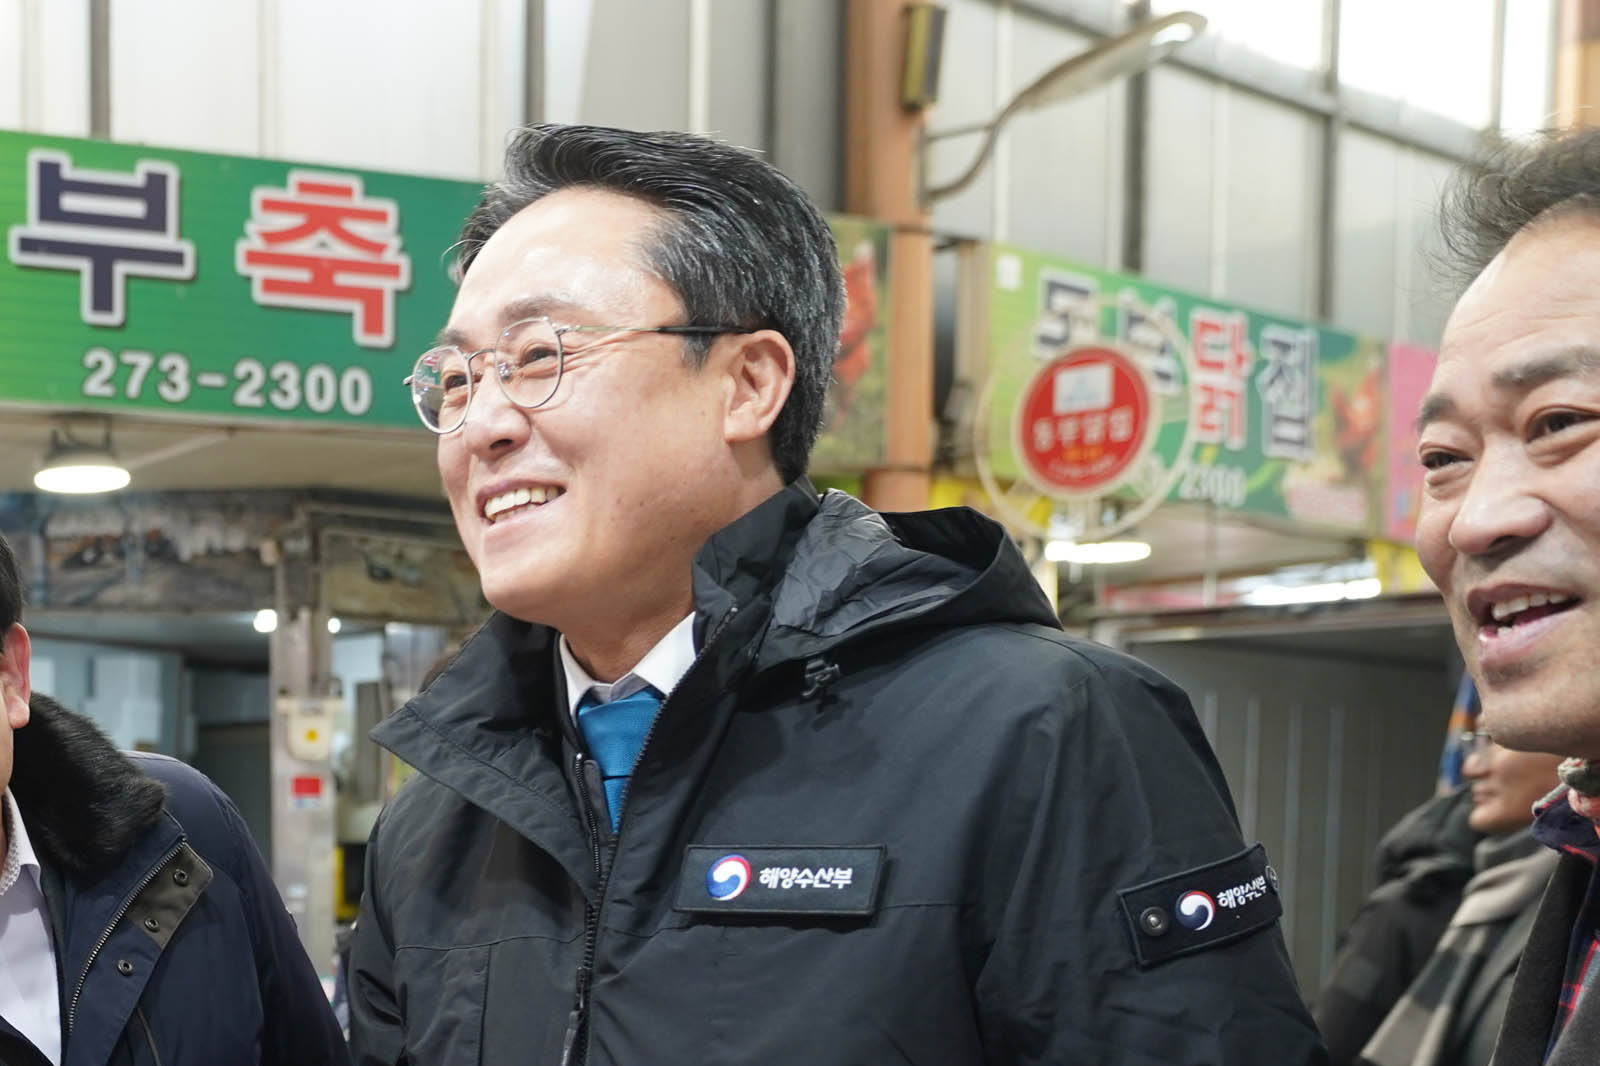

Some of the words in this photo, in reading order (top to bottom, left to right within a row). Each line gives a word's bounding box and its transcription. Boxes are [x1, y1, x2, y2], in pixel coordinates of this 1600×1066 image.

[82, 346, 373, 417] 273-2300
[758, 866, 853, 890] 해양수산부
[1215, 874, 1268, 910] 해양수산부
